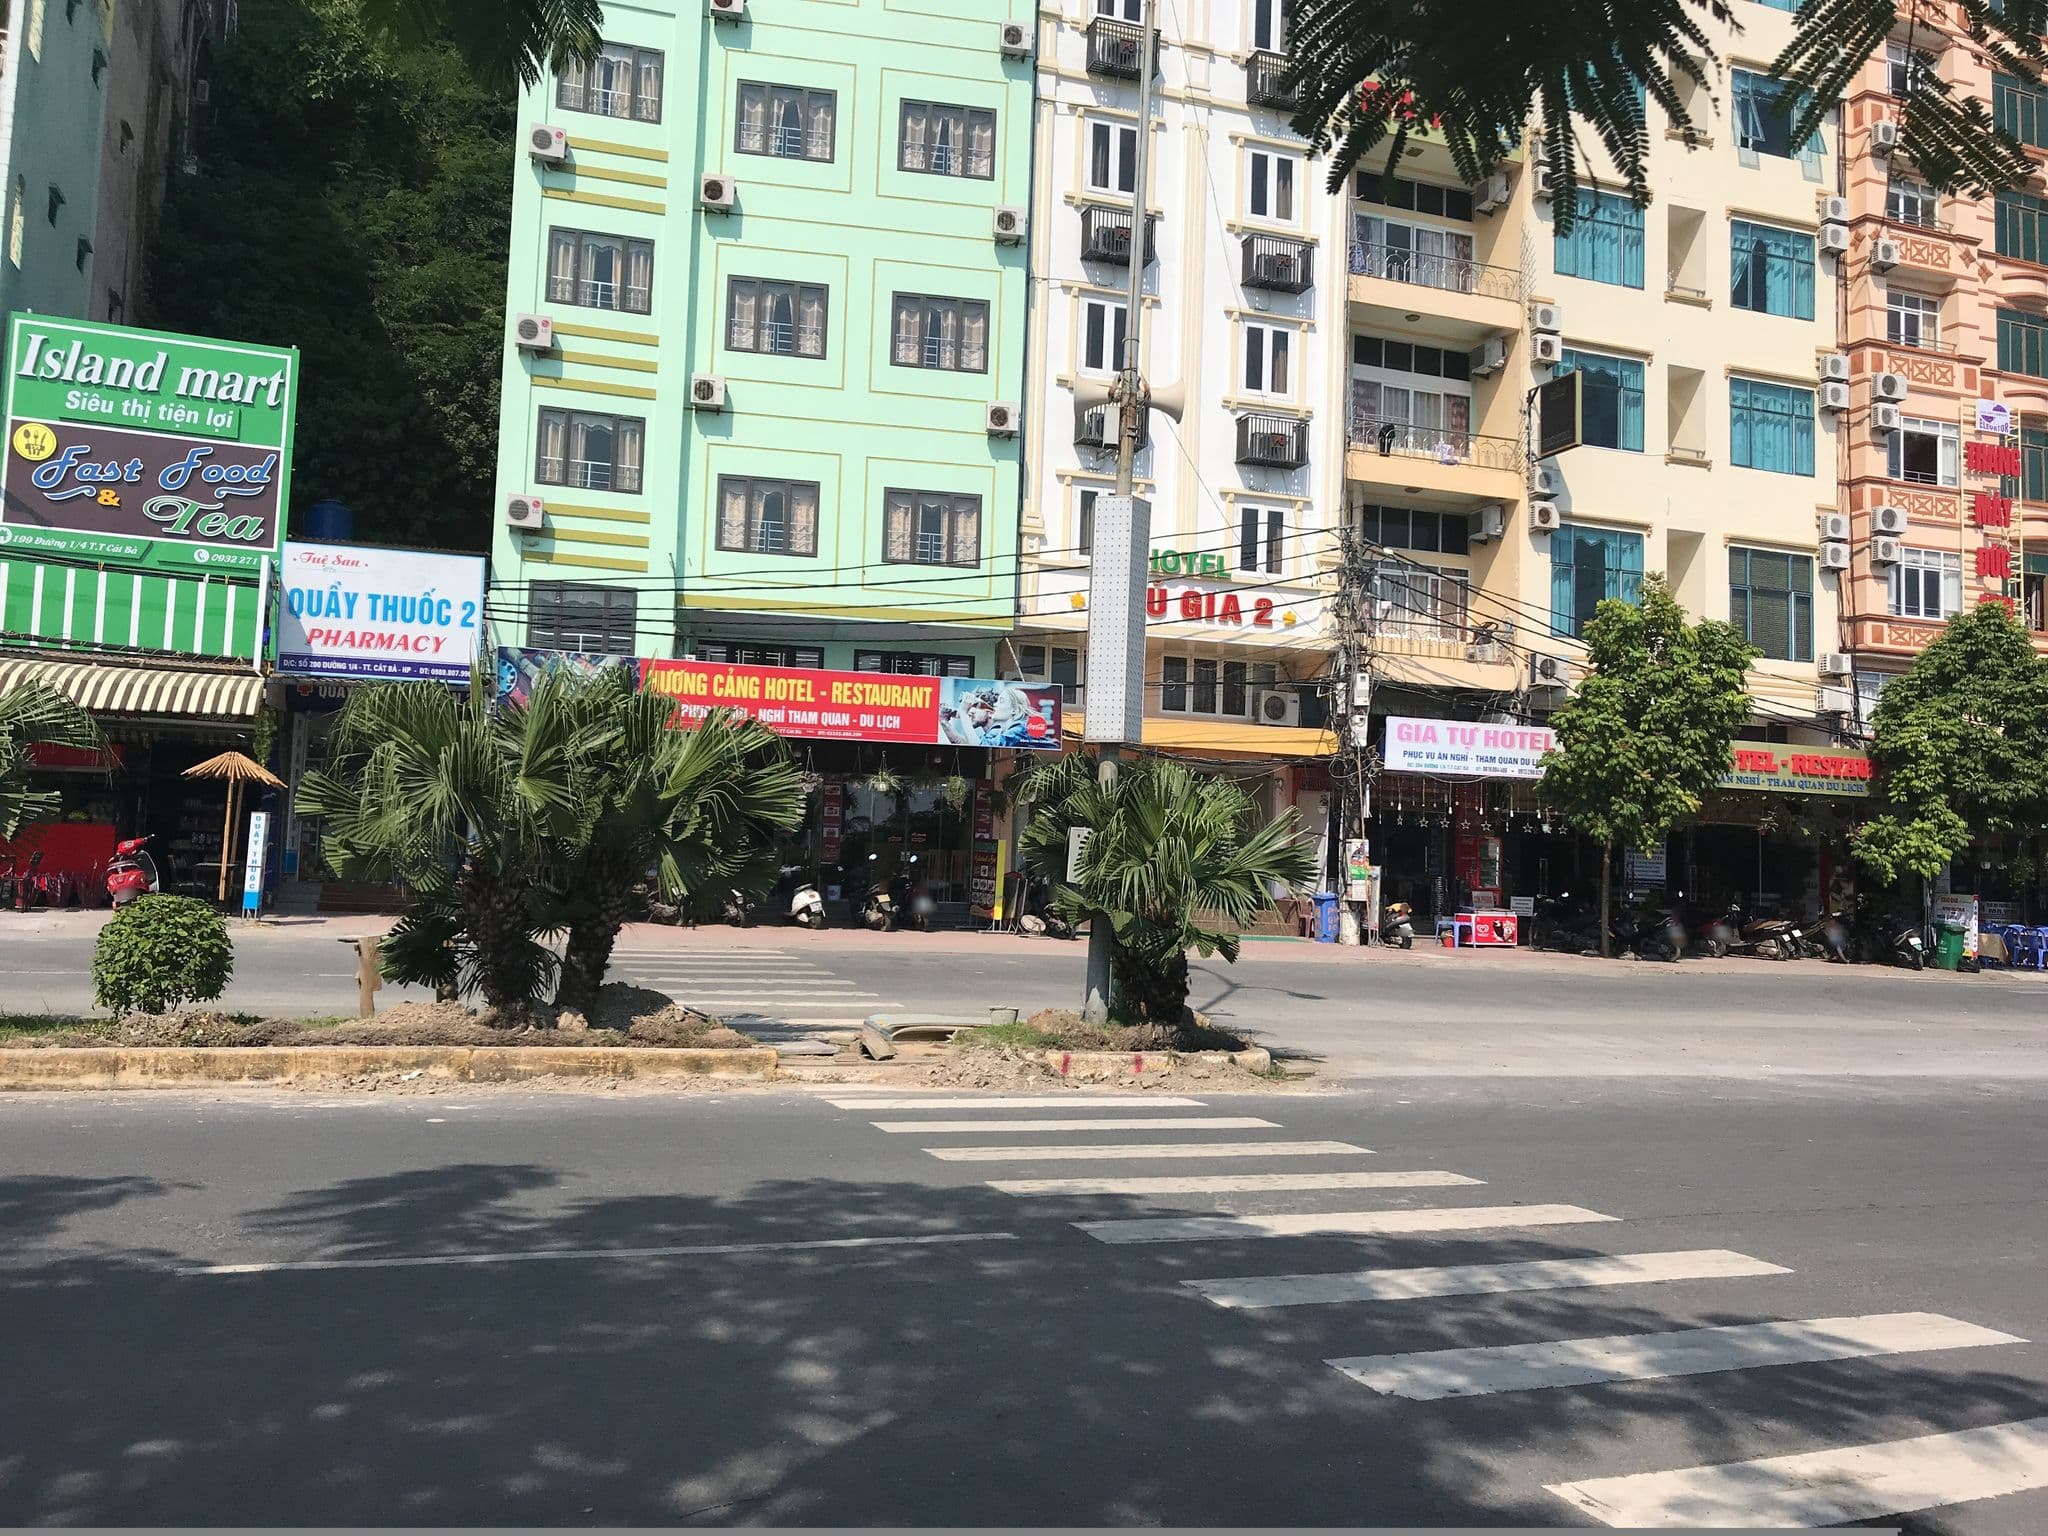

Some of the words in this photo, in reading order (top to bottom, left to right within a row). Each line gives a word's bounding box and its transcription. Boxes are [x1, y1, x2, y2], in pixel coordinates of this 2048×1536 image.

[16, 333, 168, 392] Island
[175, 366, 285, 407] mart
[65, 390, 114, 414] Siêu
[121, 399, 152, 423] thị
[158, 403, 200, 428] tiện
[205, 407, 234, 432] lợi
[31, 445, 144, 491] Fast
[158, 447, 278, 492] Food
[1965, 441, 2021, 477] THANG
[97, 488, 121, 507] &
[143, 495, 265, 541] Tea
[69, 540, 87, 550] 1/4
[211, 553, 237, 562] 0932
[238, 556, 258, 565] 271
[288, 581, 359, 619] QUẦY
[368, 588, 452, 626] THUỐC
[460, 601, 476, 628] 2
[1181, 590, 1242, 623] GIA
[1254, 598, 1274, 625] 2
[307, 628, 448, 655] PHARMACY
[713, 667, 760, 699] CẢNG
[764, 677, 816, 703] HOTEL
[831, 681, 933, 709] RESTAURANT
[788, 709, 818, 725] THAM
[821, 712, 850, 727] QUAN
[860, 714, 874, 727] DU
[877, 715, 900, 731] LỊCH
[1397, 722, 1437, 743] GIA
[1483, 729, 1556, 752] HOTEL
[1476, 755, 1496, 764] THAM
[1498, 756, 1518, 765] QUAN
[1520, 758, 1530, 766] DU
[1768, 779, 1797, 789] THAM
[1798, 780, 1825, 791] QUAN
[1826, 782, 1840, 791] DU
